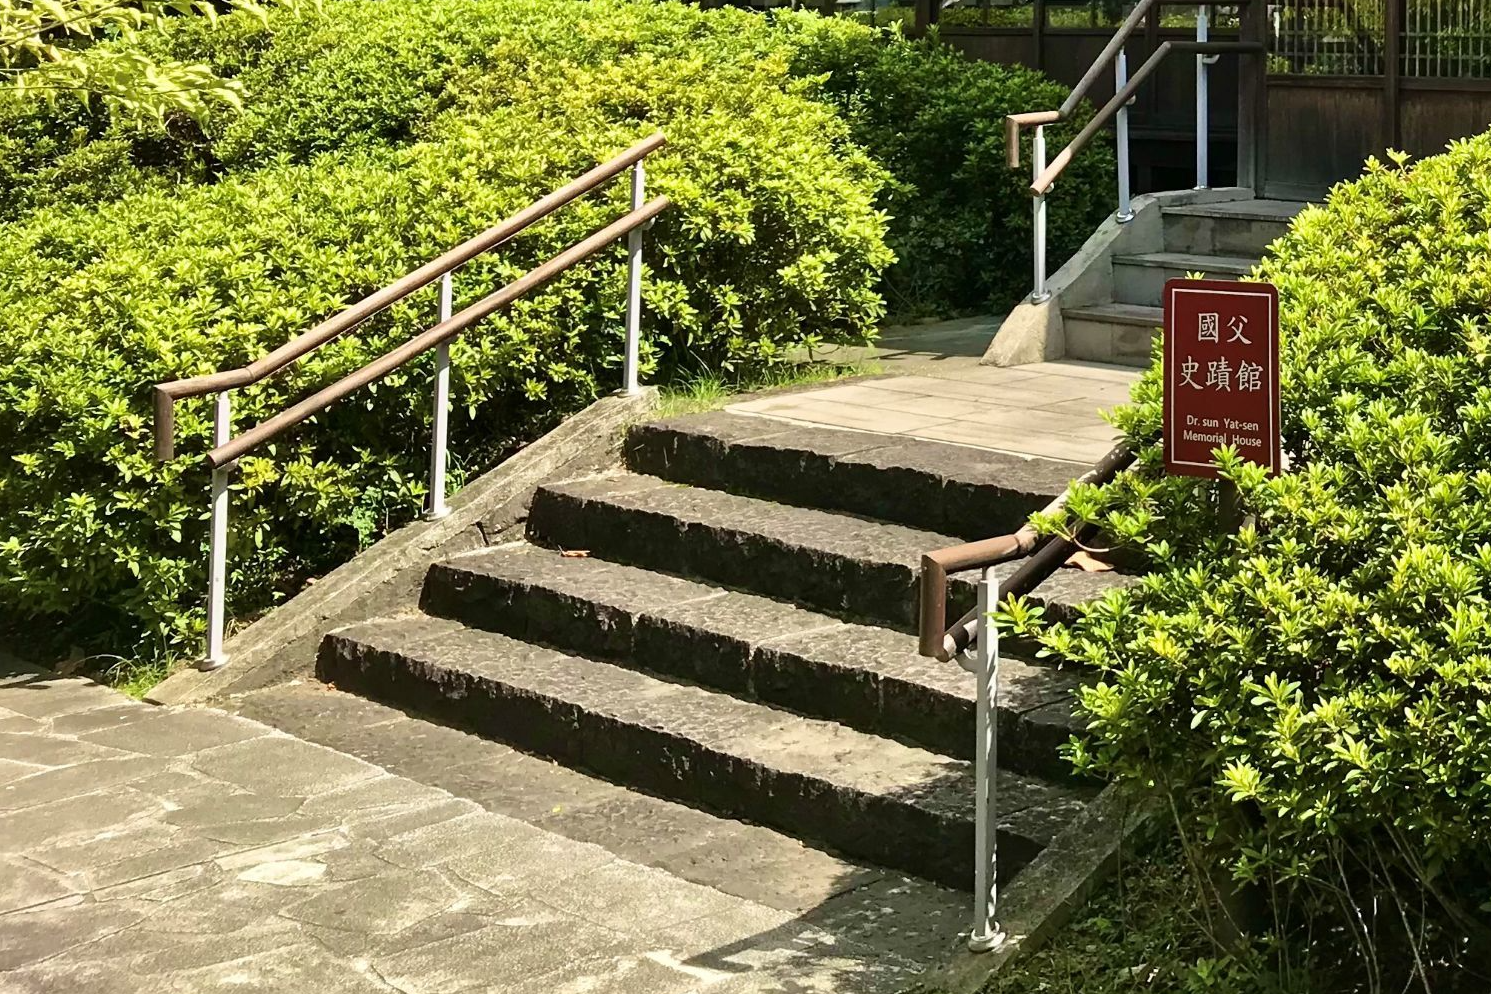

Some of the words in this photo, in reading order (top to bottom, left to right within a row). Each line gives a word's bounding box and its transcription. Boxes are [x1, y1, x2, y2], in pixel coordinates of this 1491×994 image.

[1198, 312, 1252, 345] 國父
[1178, 355, 1264, 393] 史蹟館
[1186, 414, 1200, 426] Dr.
[1202, 418, 1219, 428] sun
[1223, 418, 1259, 431] Yat-sen
[1183, 429, 1227, 444] Memorial
[1232, 434, 1262, 447] House
